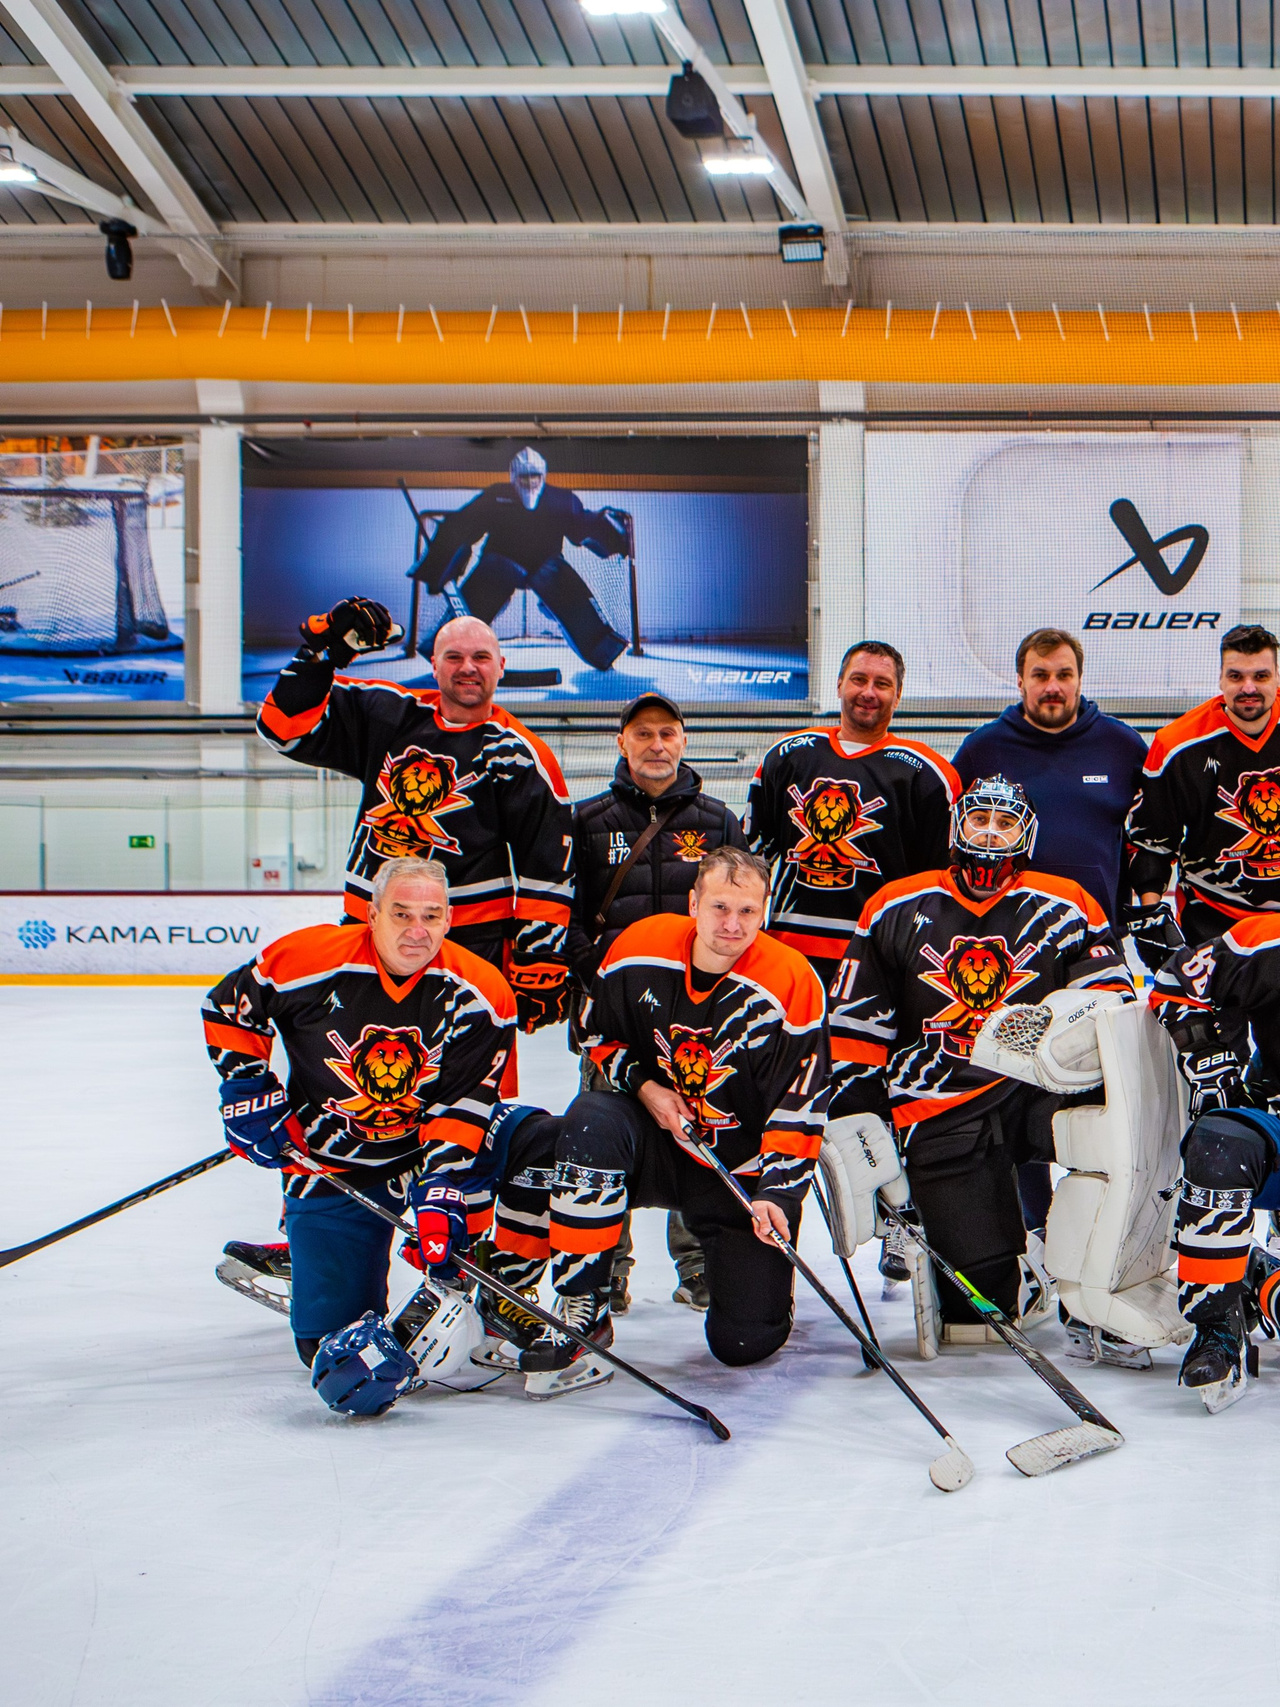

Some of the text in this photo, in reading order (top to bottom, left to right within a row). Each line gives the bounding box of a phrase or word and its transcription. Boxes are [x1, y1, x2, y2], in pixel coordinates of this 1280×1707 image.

[1082, 612, 1221, 630] BAUER
[80, 671, 169, 685] BAUER
[705, 671, 791, 685] BAUER
[609, 832, 628, 848] I.G.
[974, 866, 994, 888] 31
[1128, 914, 1166, 930] CM
[66, 926, 261, 944] KAMA FLOW
[829, 957, 860, 1001] 31
[1197, 1052, 1238, 1072] BAU
[223, 1089, 287, 1121] BAUE
[484, 1103, 523, 1151] BAUE
